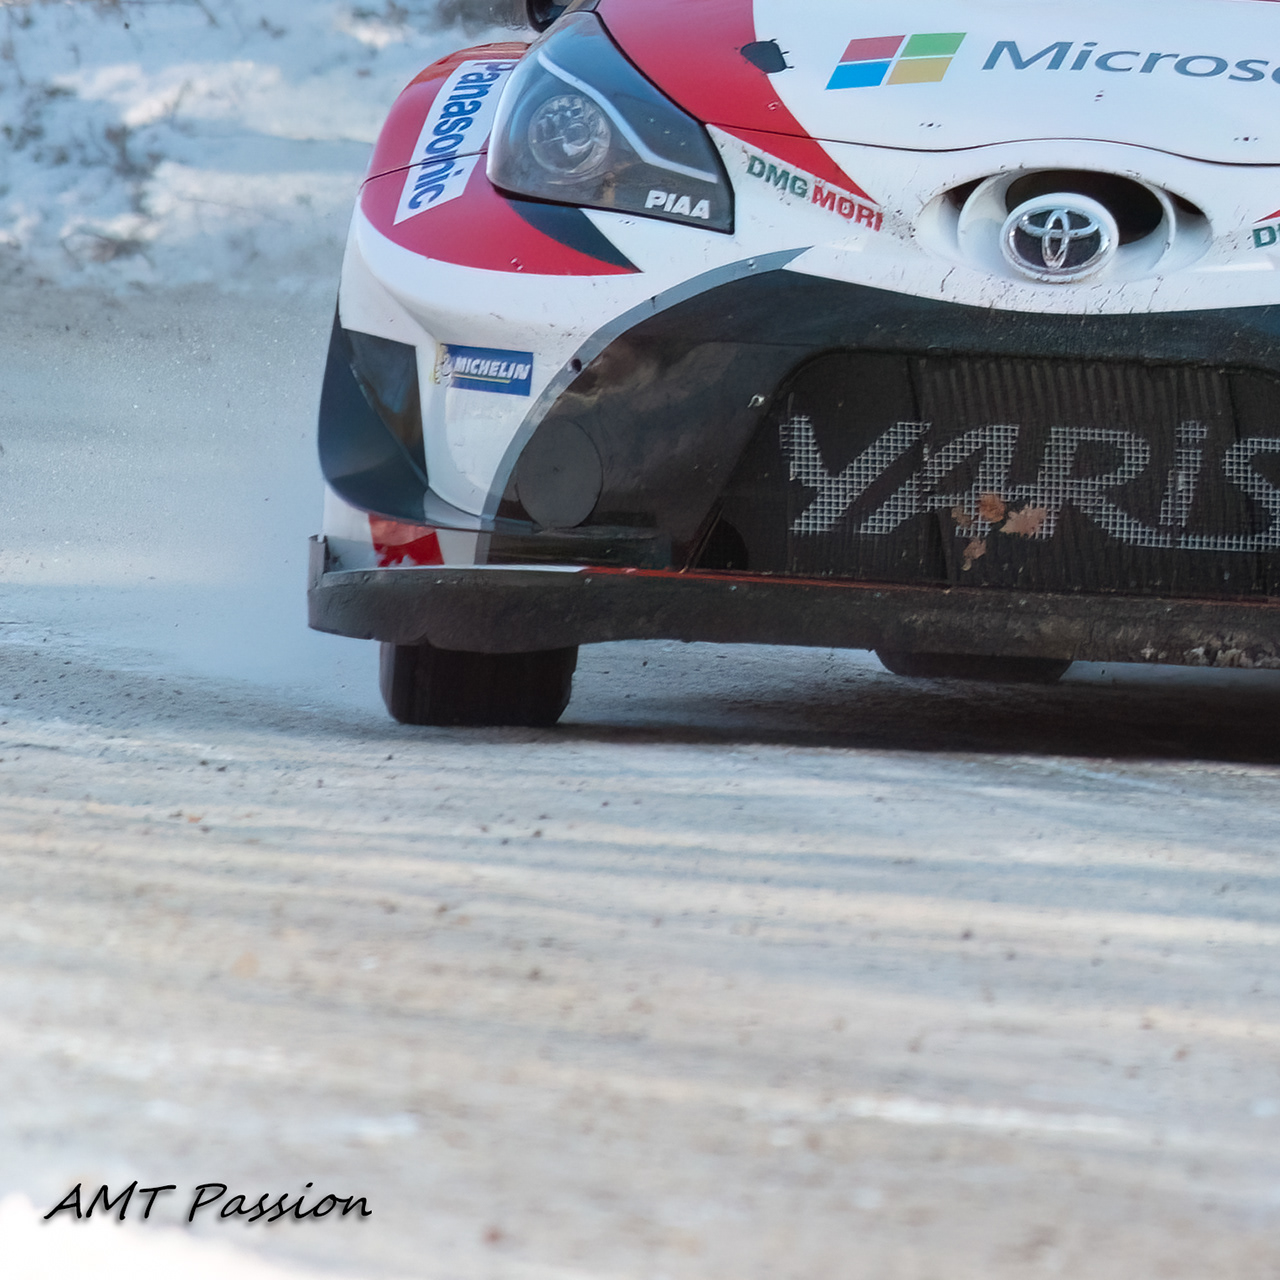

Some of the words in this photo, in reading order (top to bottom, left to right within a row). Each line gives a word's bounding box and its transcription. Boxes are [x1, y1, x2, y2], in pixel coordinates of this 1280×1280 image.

[408, 61, 514, 210] Panasonic
[645, 190, 710, 220] PIAA
[745, 153, 809, 200] DMG
[811, 184, 883, 232] MORI
[453, 357, 532, 380] MICHELIN
